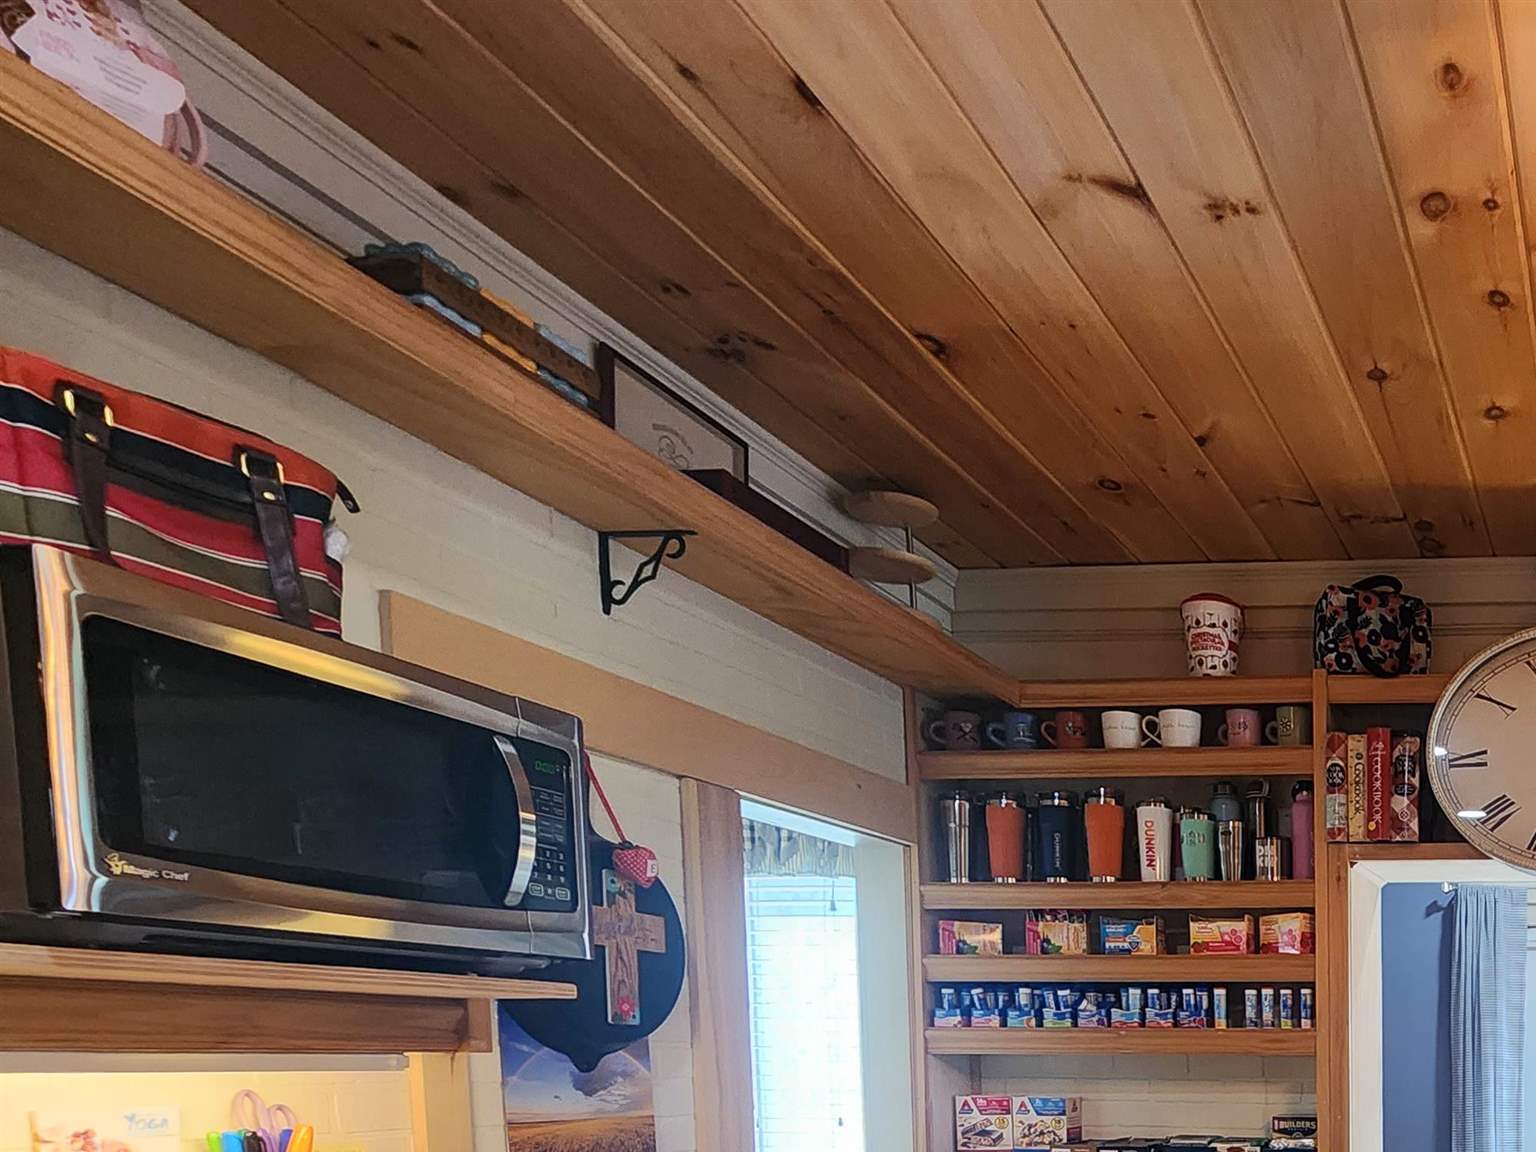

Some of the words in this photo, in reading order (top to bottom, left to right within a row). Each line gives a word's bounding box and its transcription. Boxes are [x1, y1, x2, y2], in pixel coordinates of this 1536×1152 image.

[1144, 819, 1156, 871] DUNKIN'
[161, 870, 190, 881] Chef
[125, 1115, 169, 1131] YOGA
[1279, 1120, 1316, 1130] BUILDERS
